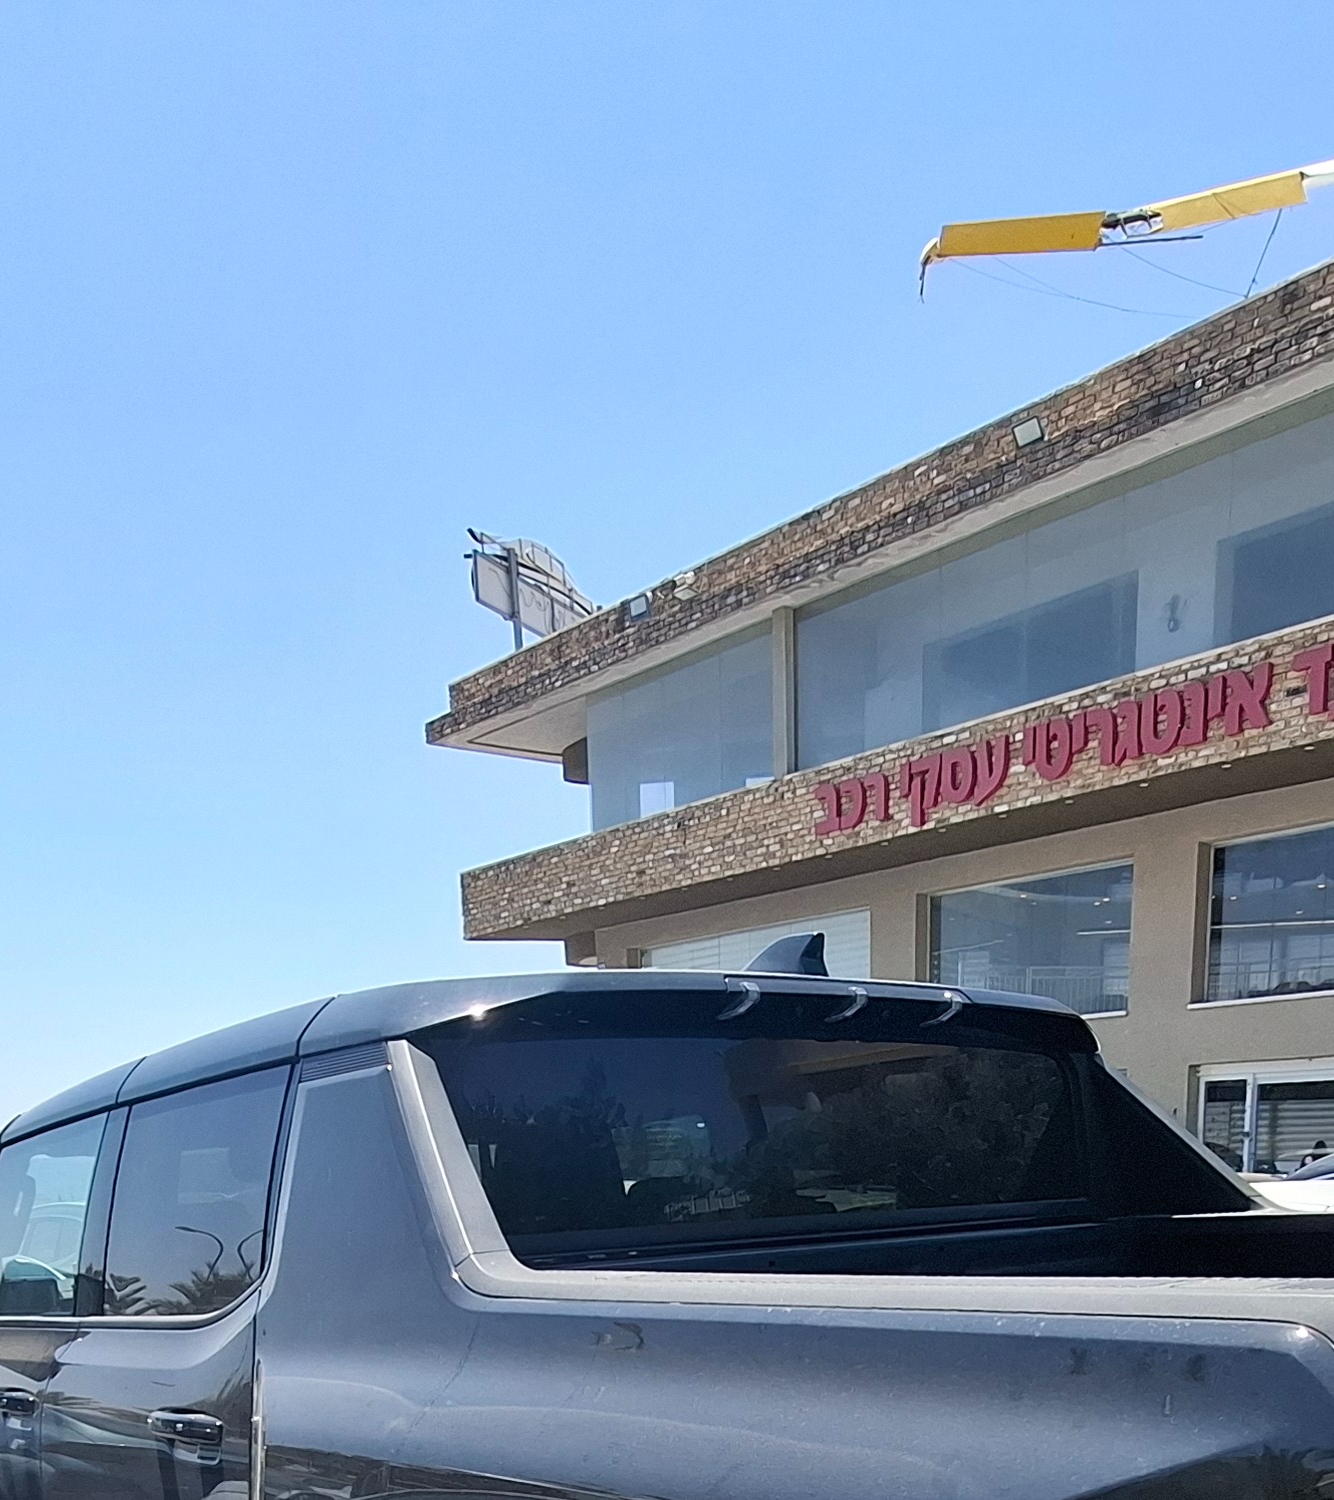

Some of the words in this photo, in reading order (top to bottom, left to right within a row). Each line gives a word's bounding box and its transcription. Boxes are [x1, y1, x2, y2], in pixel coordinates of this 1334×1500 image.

[1022, 661, 1275, 782] אינטגריטי
[814, 771, 891, 836] רכב
[899, 734, 1011, 828] עסקי
